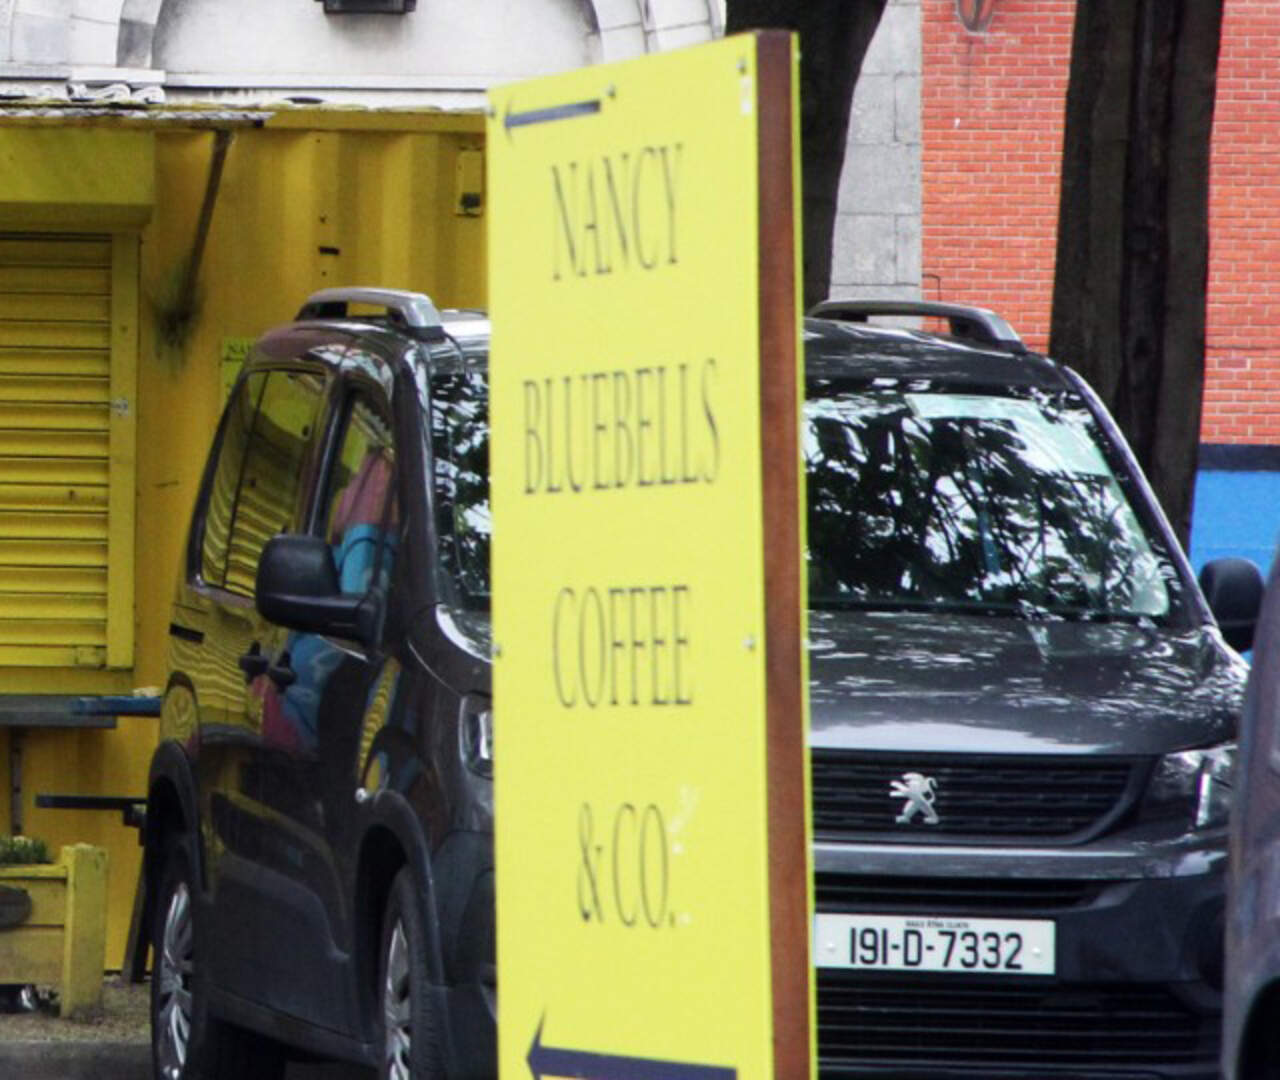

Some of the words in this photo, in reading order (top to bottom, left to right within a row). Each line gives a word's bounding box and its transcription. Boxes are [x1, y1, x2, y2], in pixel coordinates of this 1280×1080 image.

[550, 142, 685, 282] NANCY
[522, 357, 721, 496] BLUEBELLS
[552, 586, 693, 709] COFFEE
[850, 927, 1024, 971] 191-D-7332
